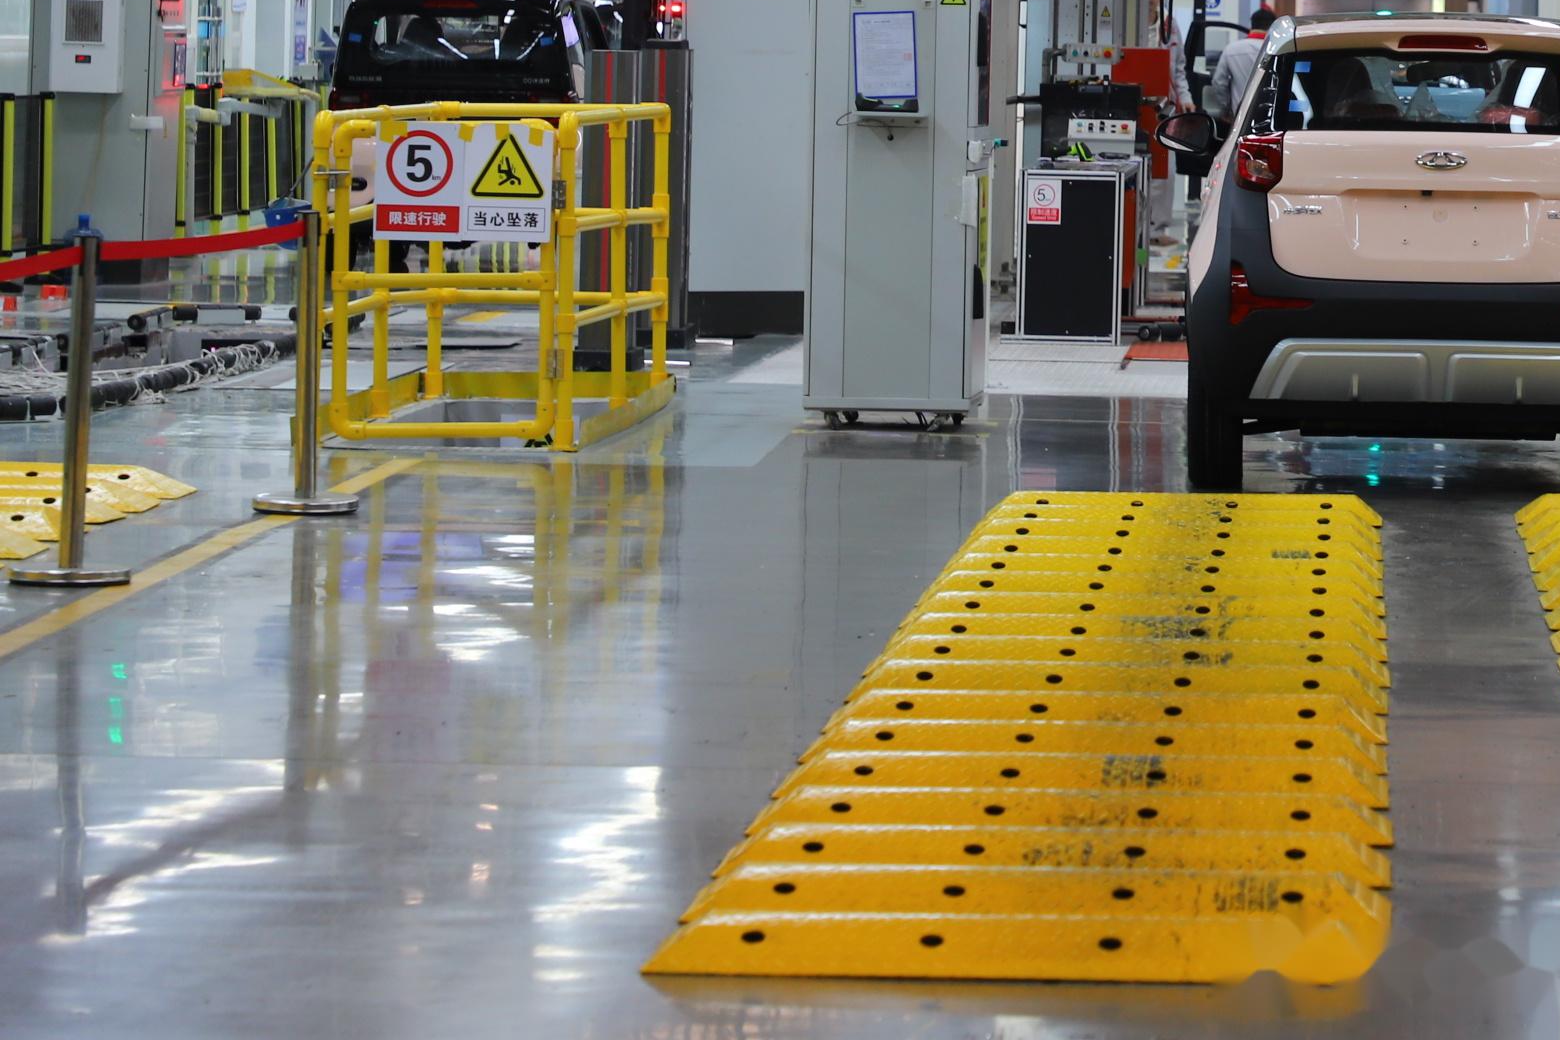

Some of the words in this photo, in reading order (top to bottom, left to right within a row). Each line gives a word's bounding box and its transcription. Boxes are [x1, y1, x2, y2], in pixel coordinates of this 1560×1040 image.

[406, 144, 433, 183] 5
[1037, 188, 1046, 201] 5
[388, 211, 447, 226] 限速行驶
[473, 212, 539, 228] 当心坠落
